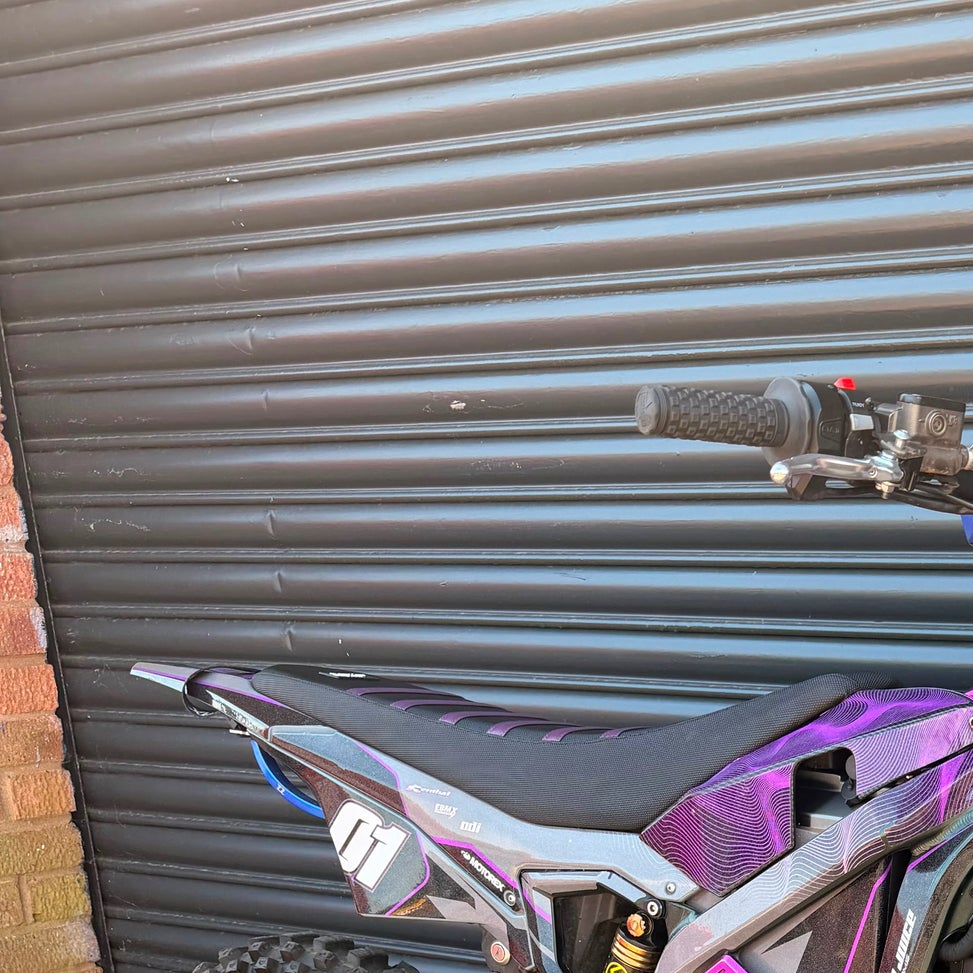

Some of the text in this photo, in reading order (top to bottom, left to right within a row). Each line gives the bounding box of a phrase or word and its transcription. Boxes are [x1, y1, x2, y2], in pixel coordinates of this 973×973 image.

[330, 799, 412, 891] 01
[460, 821, 482, 833] odi
[469, 855, 506, 893] MOTOREX
